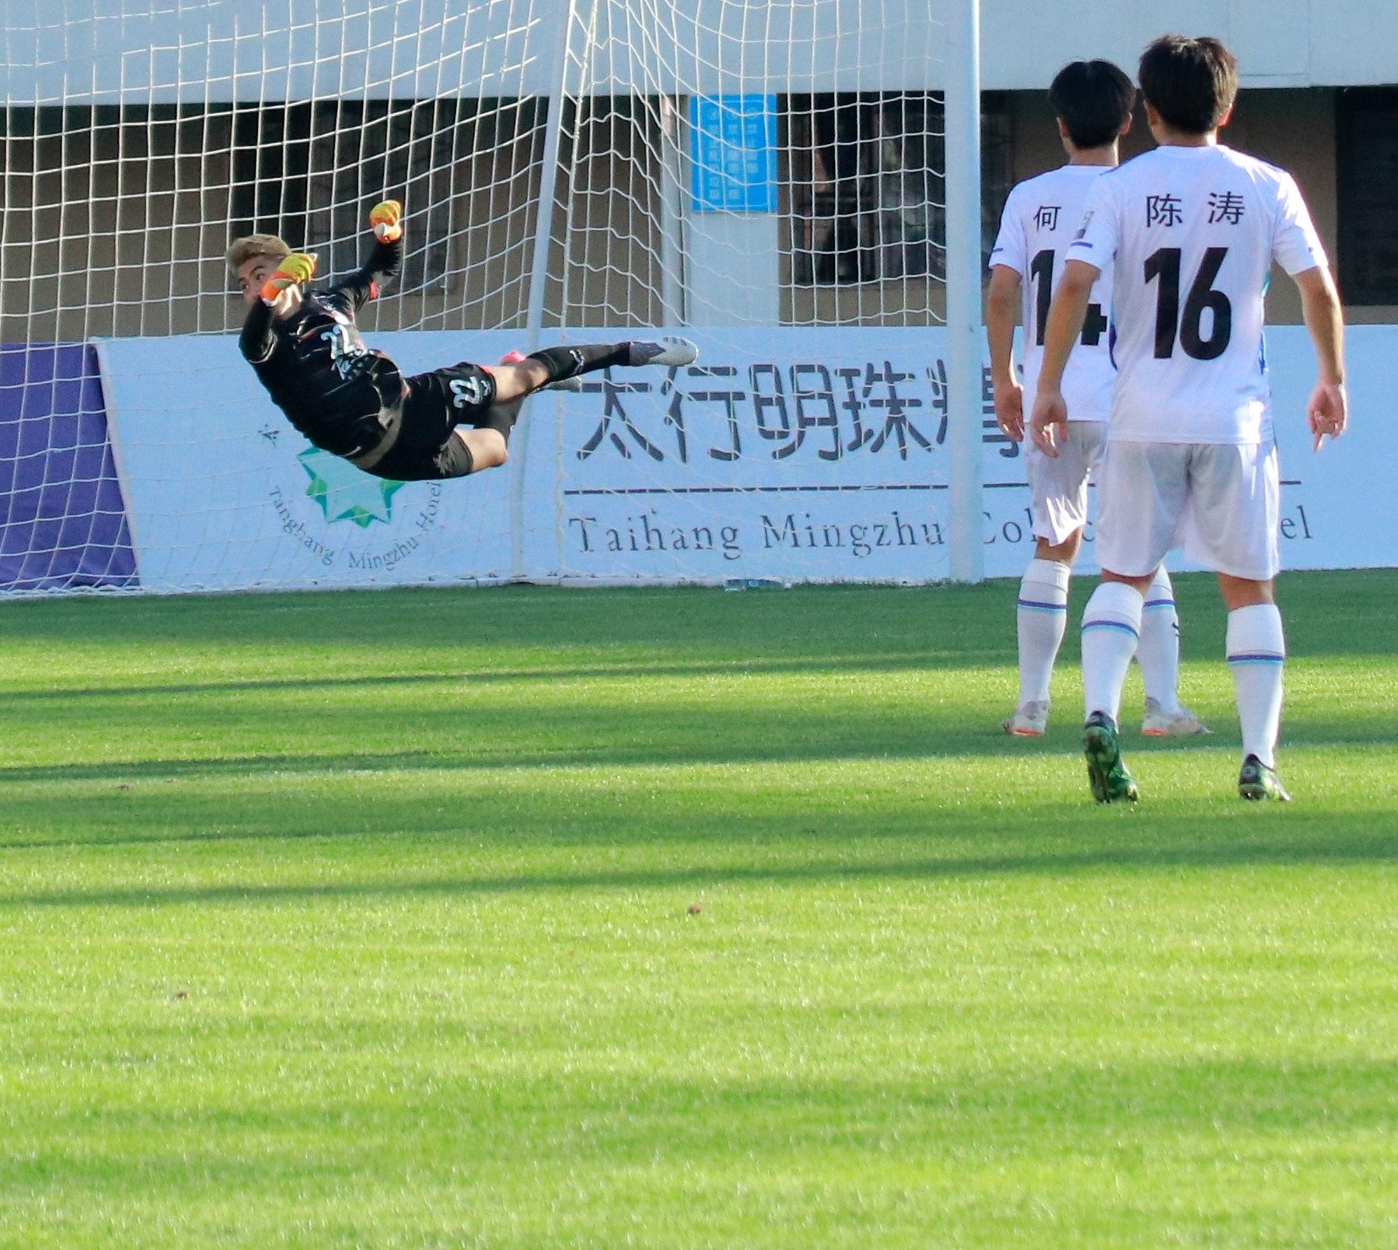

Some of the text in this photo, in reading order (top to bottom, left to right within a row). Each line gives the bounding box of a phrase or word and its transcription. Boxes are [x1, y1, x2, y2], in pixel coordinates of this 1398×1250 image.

[1034, 205, 1062, 232] 何
[1143, 247, 1232, 361] 16
[569, 510, 739, 560] Taihang
[760, 511, 945, 558] Mingzhu
